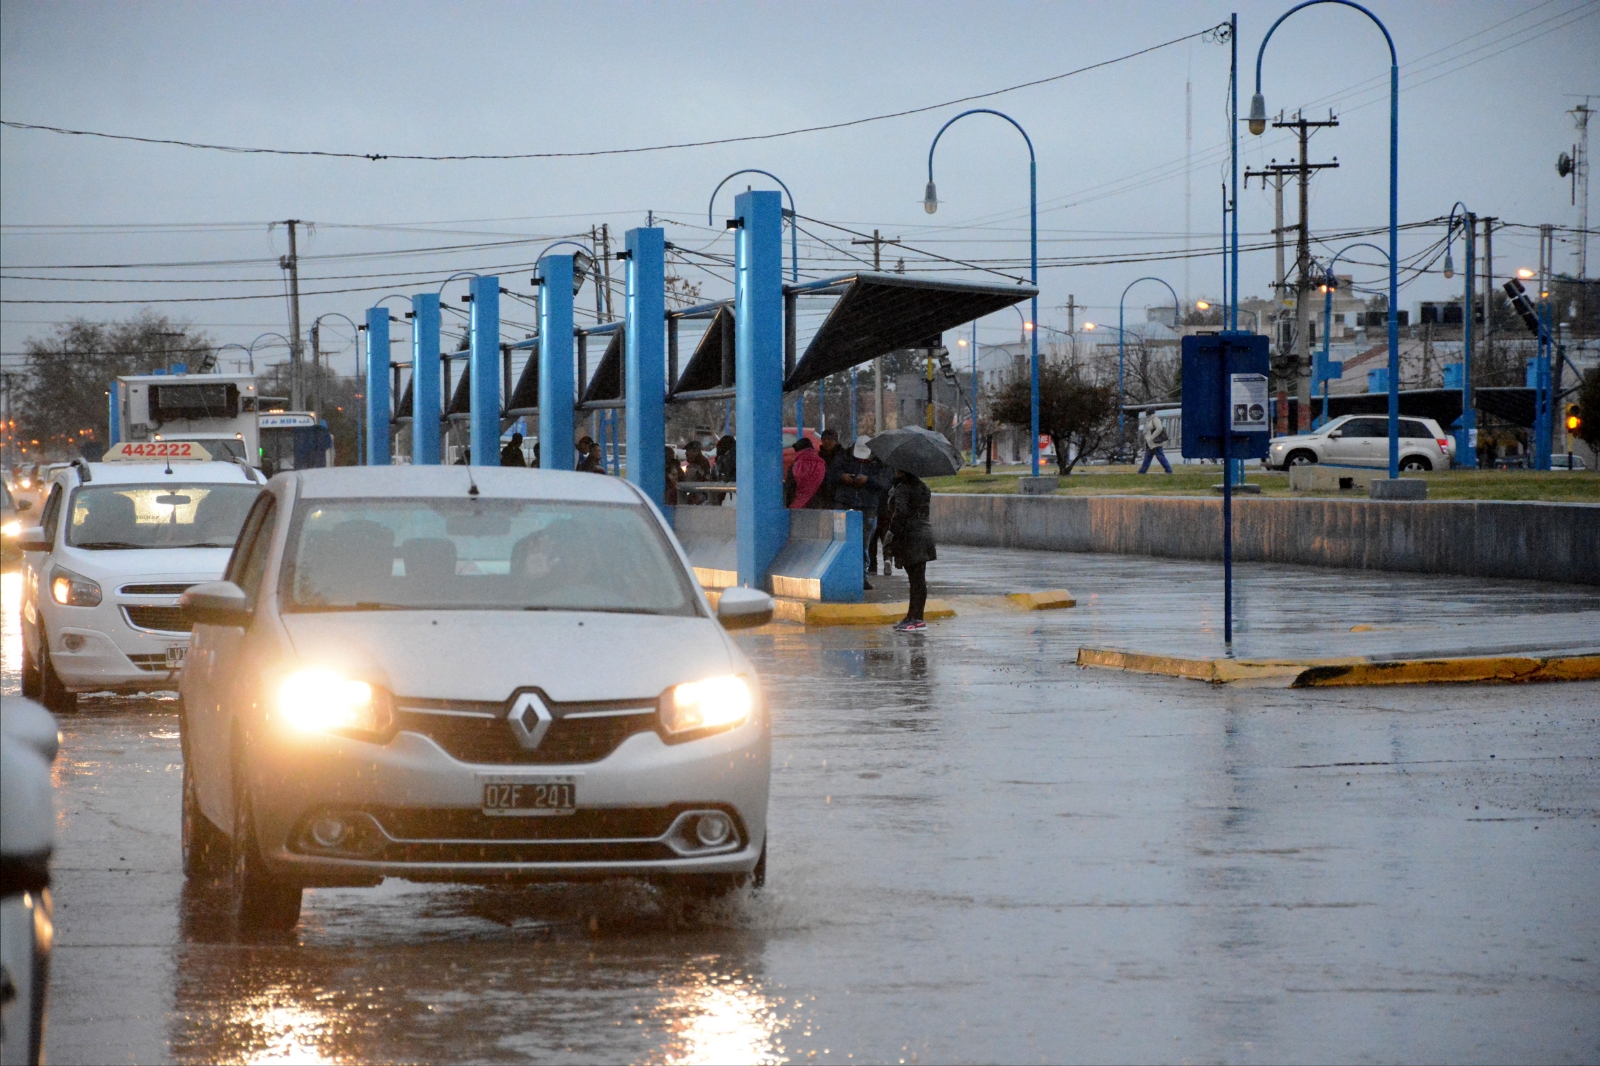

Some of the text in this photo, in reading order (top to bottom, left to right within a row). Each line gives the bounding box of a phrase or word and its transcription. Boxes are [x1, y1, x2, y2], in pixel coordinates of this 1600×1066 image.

[121, 443, 191, 456] 442222
[487, 785, 571, 808] OZF 241
